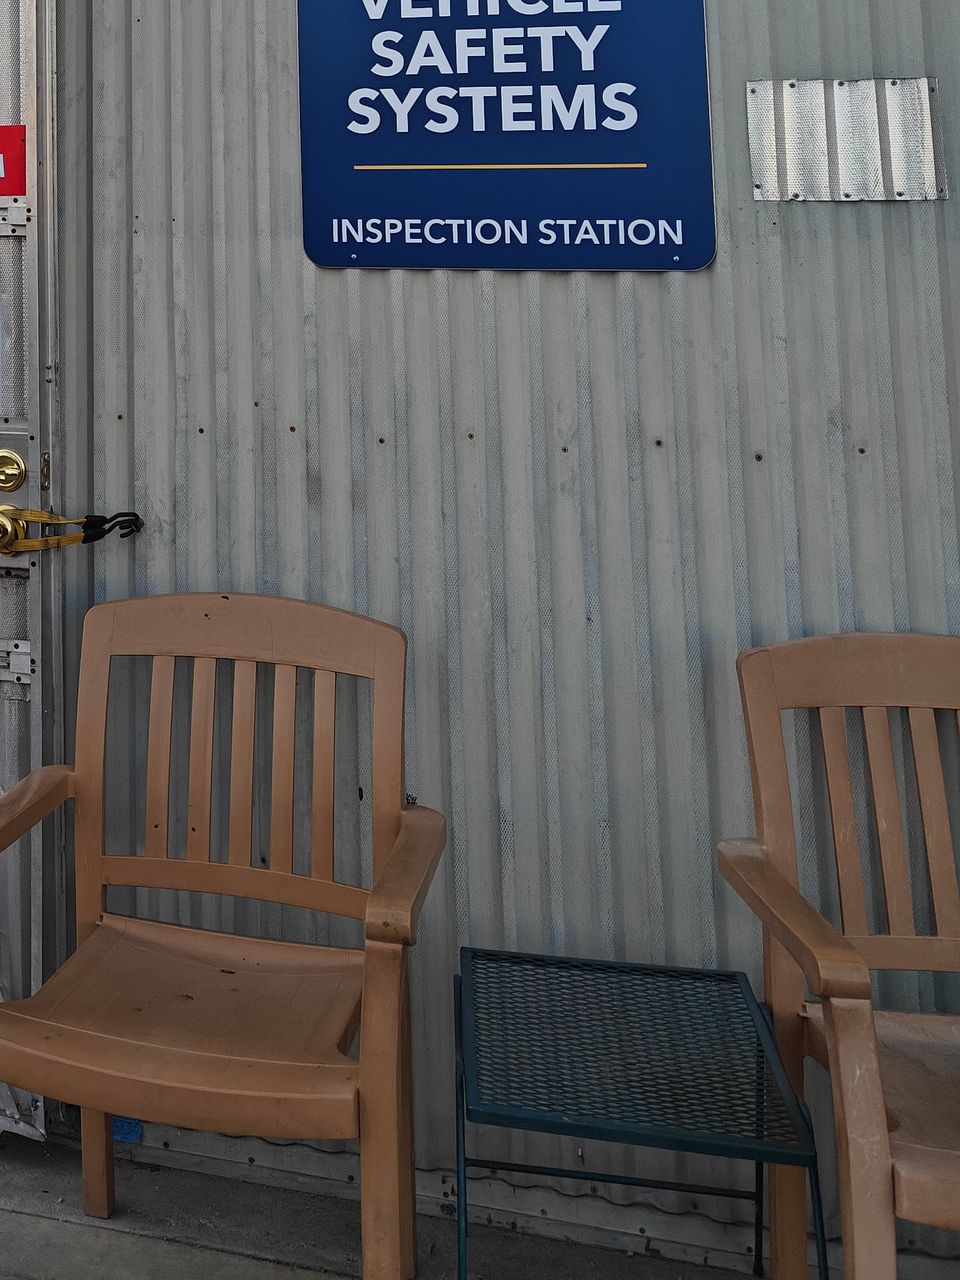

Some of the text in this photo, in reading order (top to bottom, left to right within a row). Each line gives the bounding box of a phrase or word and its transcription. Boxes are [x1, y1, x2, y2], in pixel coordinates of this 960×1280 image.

[370, 24, 611, 78] SAFETY
[346, 83, 638, 135] SYSTEMS
[331, 218, 684, 245] INSPECTION STATION
